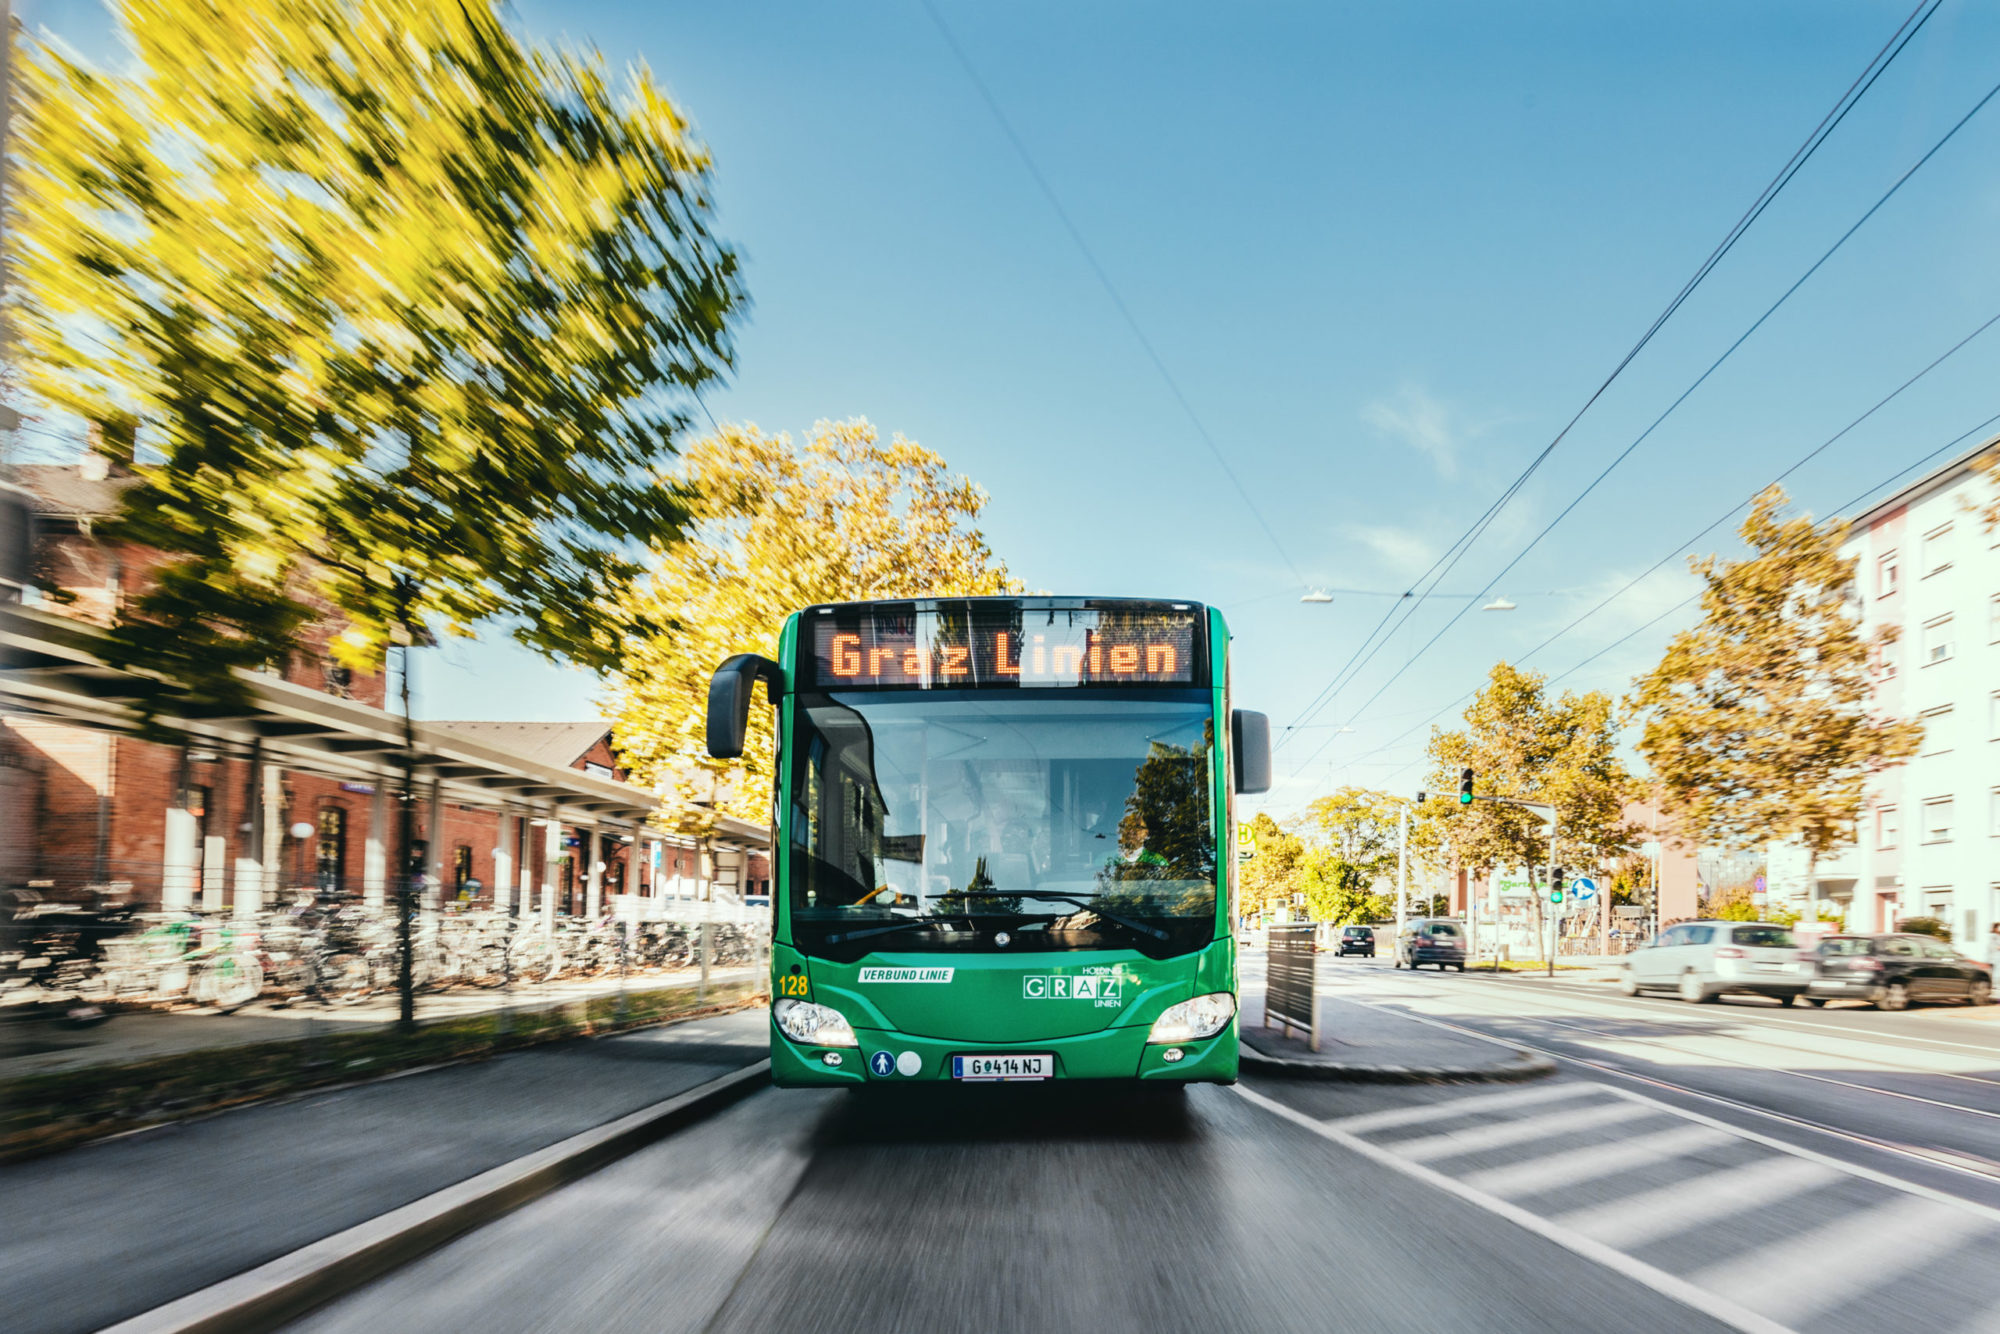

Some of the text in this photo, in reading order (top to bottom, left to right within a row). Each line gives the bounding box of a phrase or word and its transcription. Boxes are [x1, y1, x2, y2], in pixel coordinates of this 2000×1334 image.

[833, 632, 1175, 675] Graz Linien
[864, 970, 949, 980] VERBUND LINIE
[779, 976, 807, 995] 128
[1026, 978, 1117, 997] GRAZ
[993, 1060, 1019, 1074] 414
[1023, 1059, 1042, 1074] NJ
